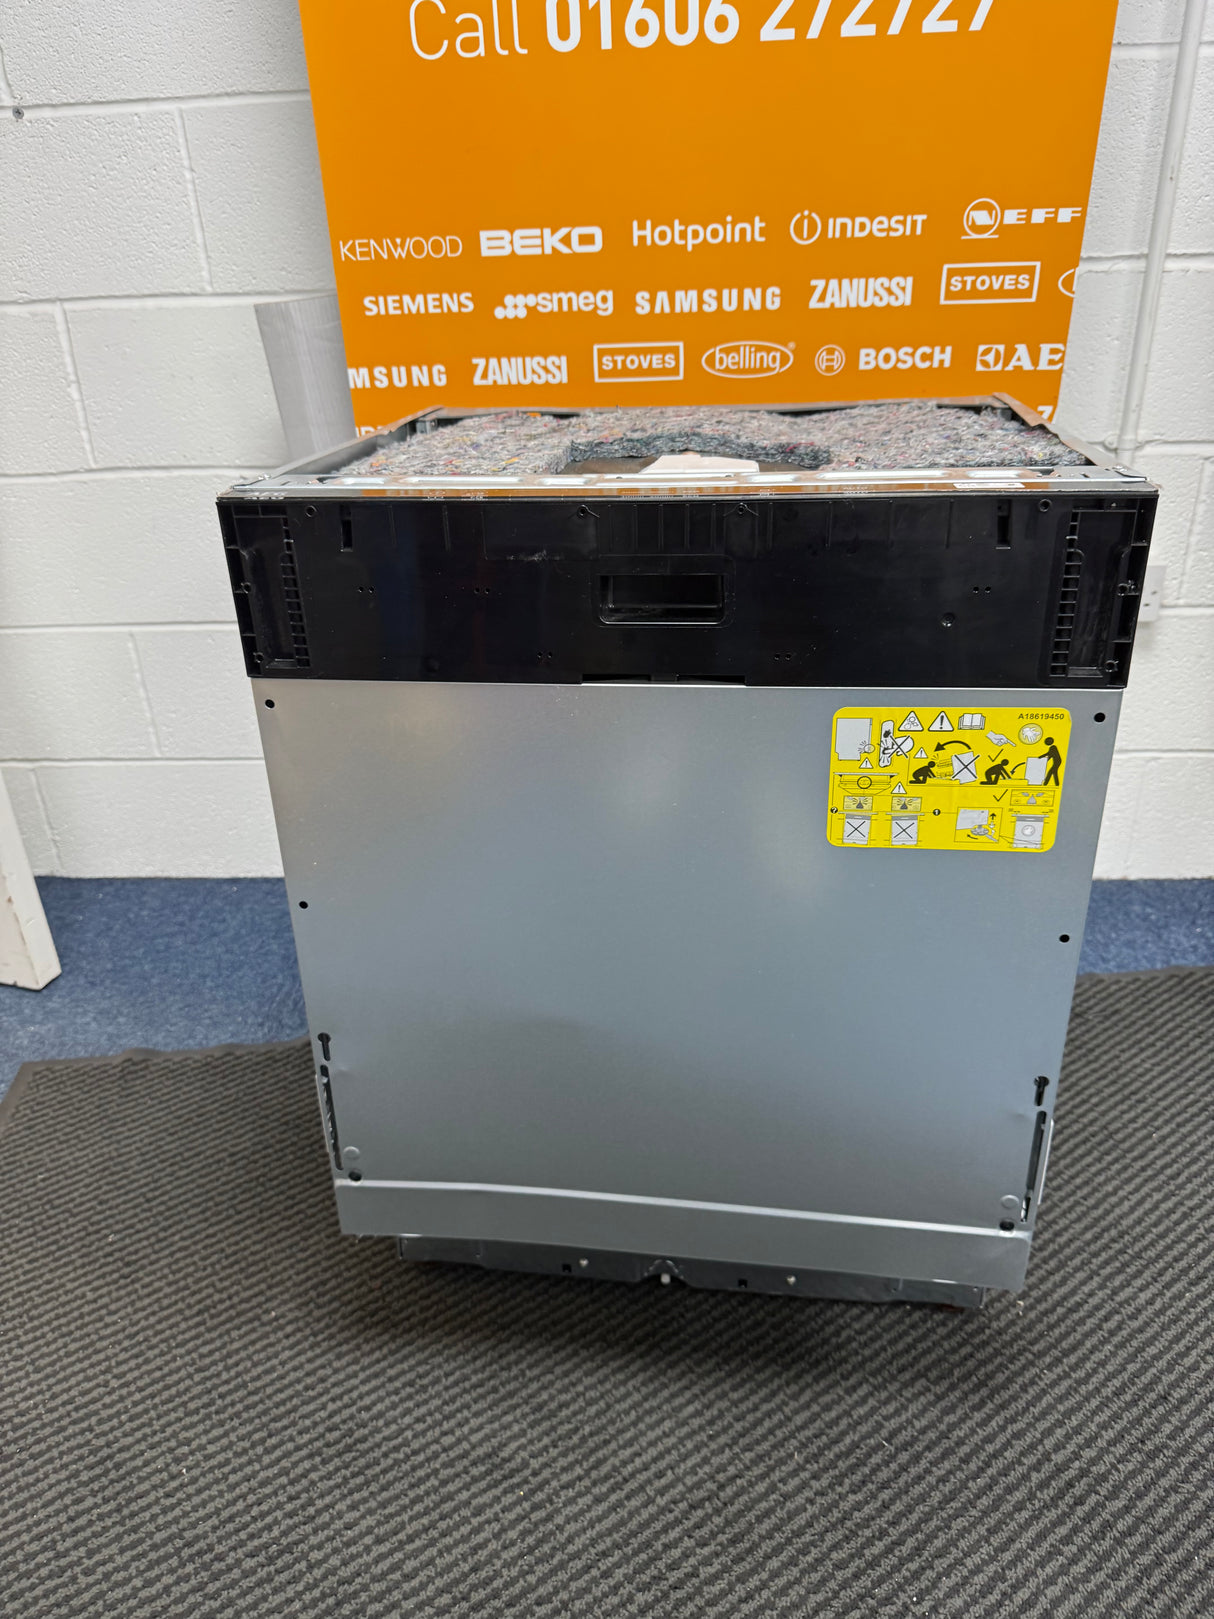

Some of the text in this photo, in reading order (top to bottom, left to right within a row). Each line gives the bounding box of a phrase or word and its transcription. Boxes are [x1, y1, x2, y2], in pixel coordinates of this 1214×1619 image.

[409, 0, 528, 61] Call
[545, 0, 740, 53] 01606
[339, 235, 463, 262] KENWOOD
[479, 225, 603, 257] BEKO
[632, 215, 766, 252] Hotpoint
[967, 206, 1083, 227] NEFF
[363, 273, 1031, 317] SIEMENS smeg SAMSUNG ZANUSSI STOVES
[471, 355, 568, 386] ZANUSSI
[601, 353, 677, 371] STOVES
[715, 345, 781, 373] belling
[858, 345, 953, 371] BOSCH
